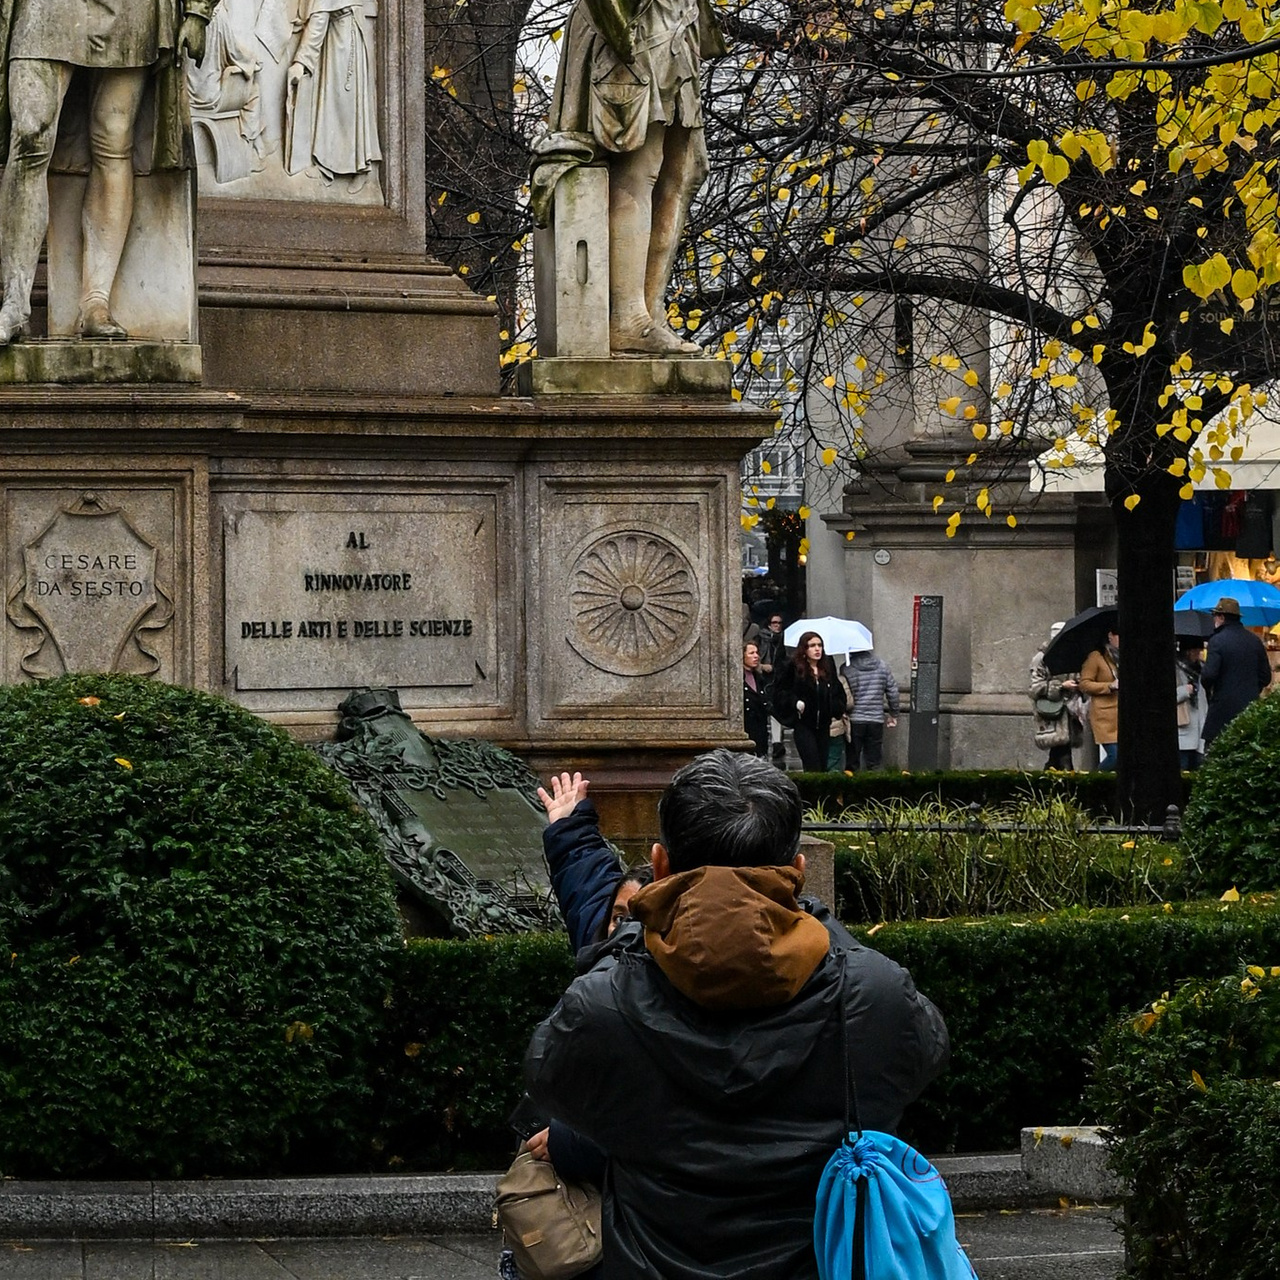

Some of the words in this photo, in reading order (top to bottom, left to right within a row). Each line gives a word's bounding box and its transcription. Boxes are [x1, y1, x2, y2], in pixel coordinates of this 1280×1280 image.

[345, 531, 370, 549] AL
[45, 554, 137, 570] CESARE
[37, 581, 62, 596] DA
[70, 581, 144, 597] SESTO
[304, 573, 412, 591] RINNOVATORE
[241, 621, 292, 639] DELLE
[297, 621, 332, 638] ARTI
[338, 621, 347, 638] E
[354, 620, 403, 638] DELLE
[409, 619, 473, 637] SCIENZE
